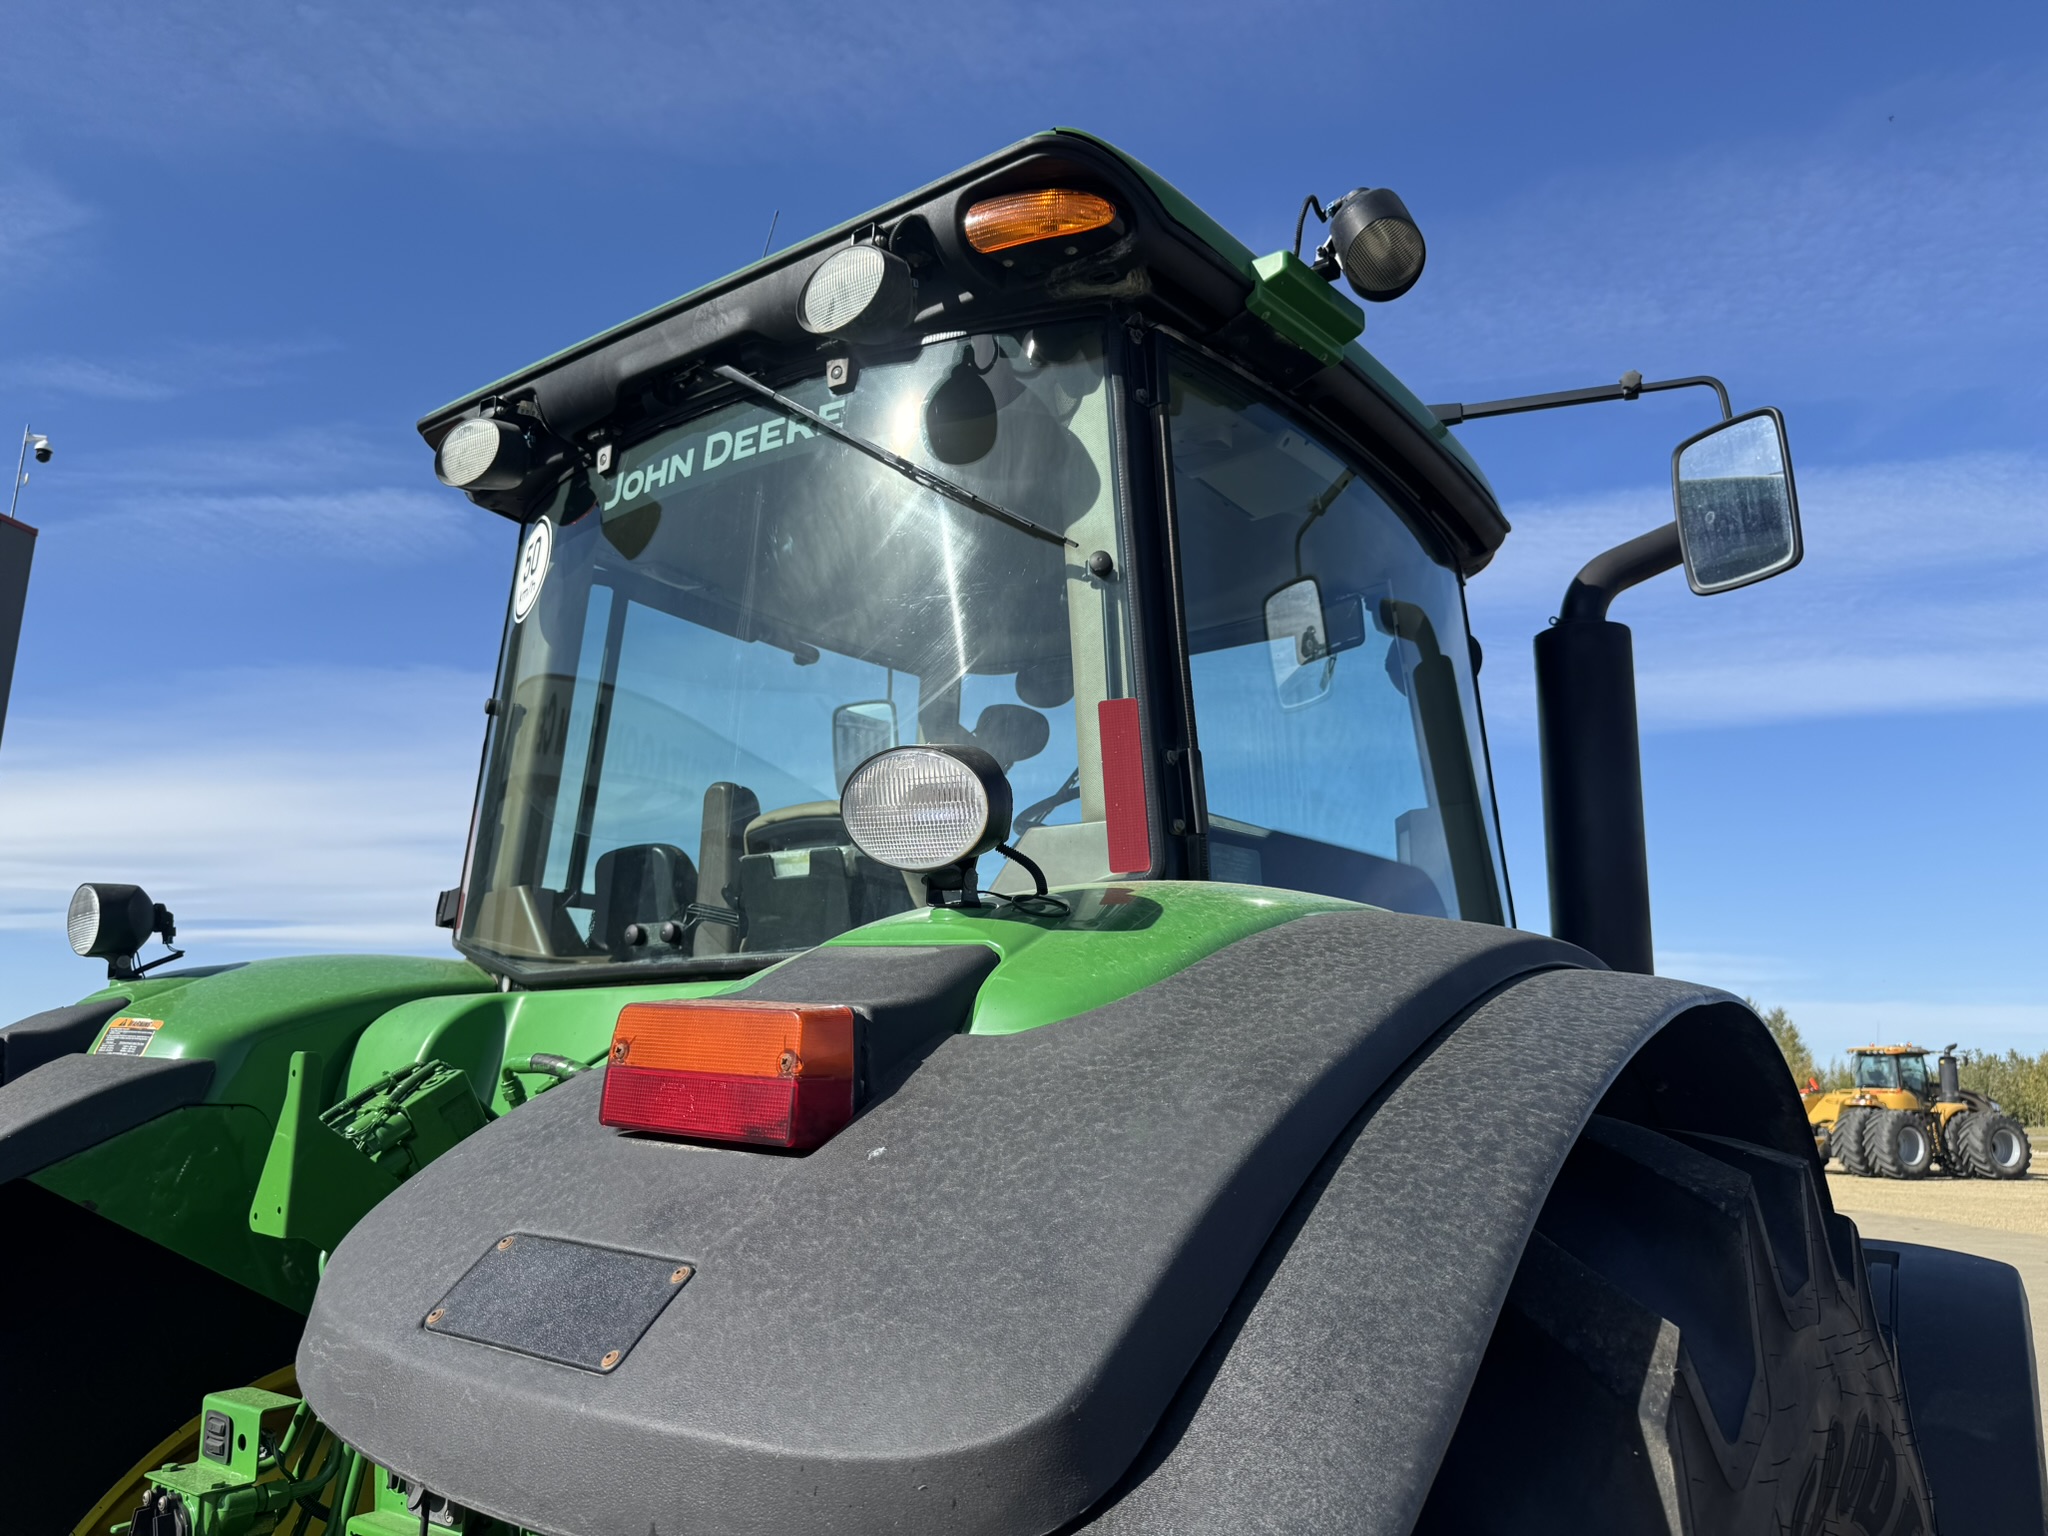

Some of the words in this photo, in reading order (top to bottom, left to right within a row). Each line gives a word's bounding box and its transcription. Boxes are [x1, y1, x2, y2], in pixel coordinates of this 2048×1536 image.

[604, 448, 695, 511] JOHN
[702, 399, 846, 471] DEERE
[523, 535, 542, 583] 50
